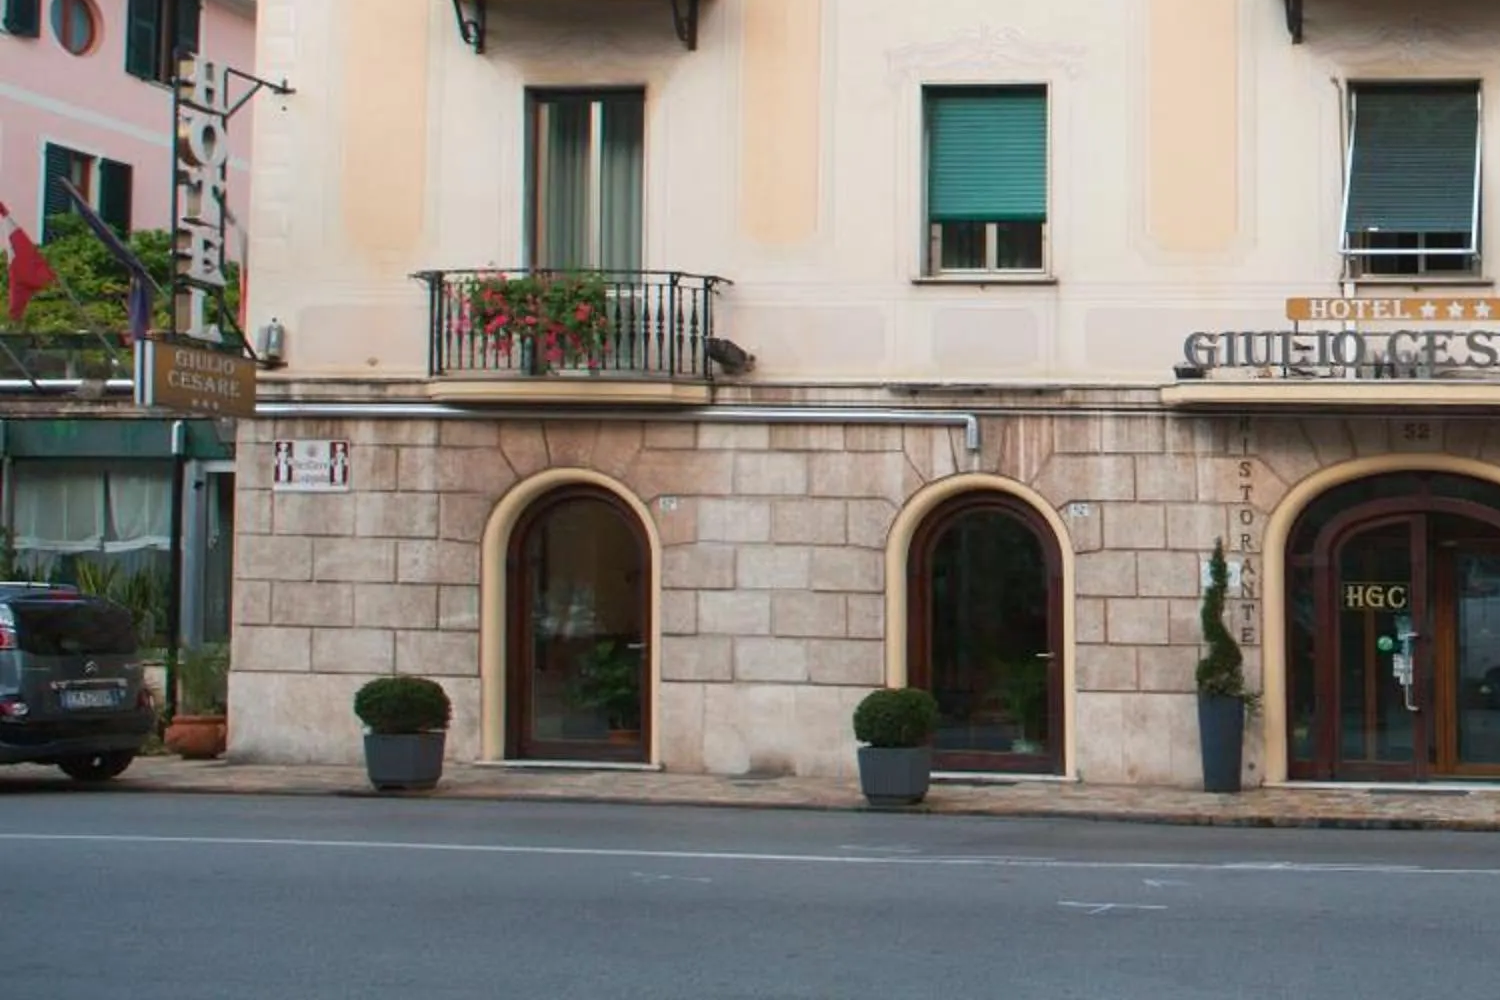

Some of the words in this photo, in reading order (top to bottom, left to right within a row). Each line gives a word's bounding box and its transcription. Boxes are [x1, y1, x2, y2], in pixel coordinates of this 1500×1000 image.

[184, 52, 229, 345] HOTEL
[1309, 299, 1411, 320] HOTEL
[175, 349, 235, 375] GIULIO
[1184, 331, 1366, 369] GIULIO
[168, 369, 241, 398] CESARE
[1403, 422, 1430, 440] 52
[1345, 585, 1406, 609] HGC
